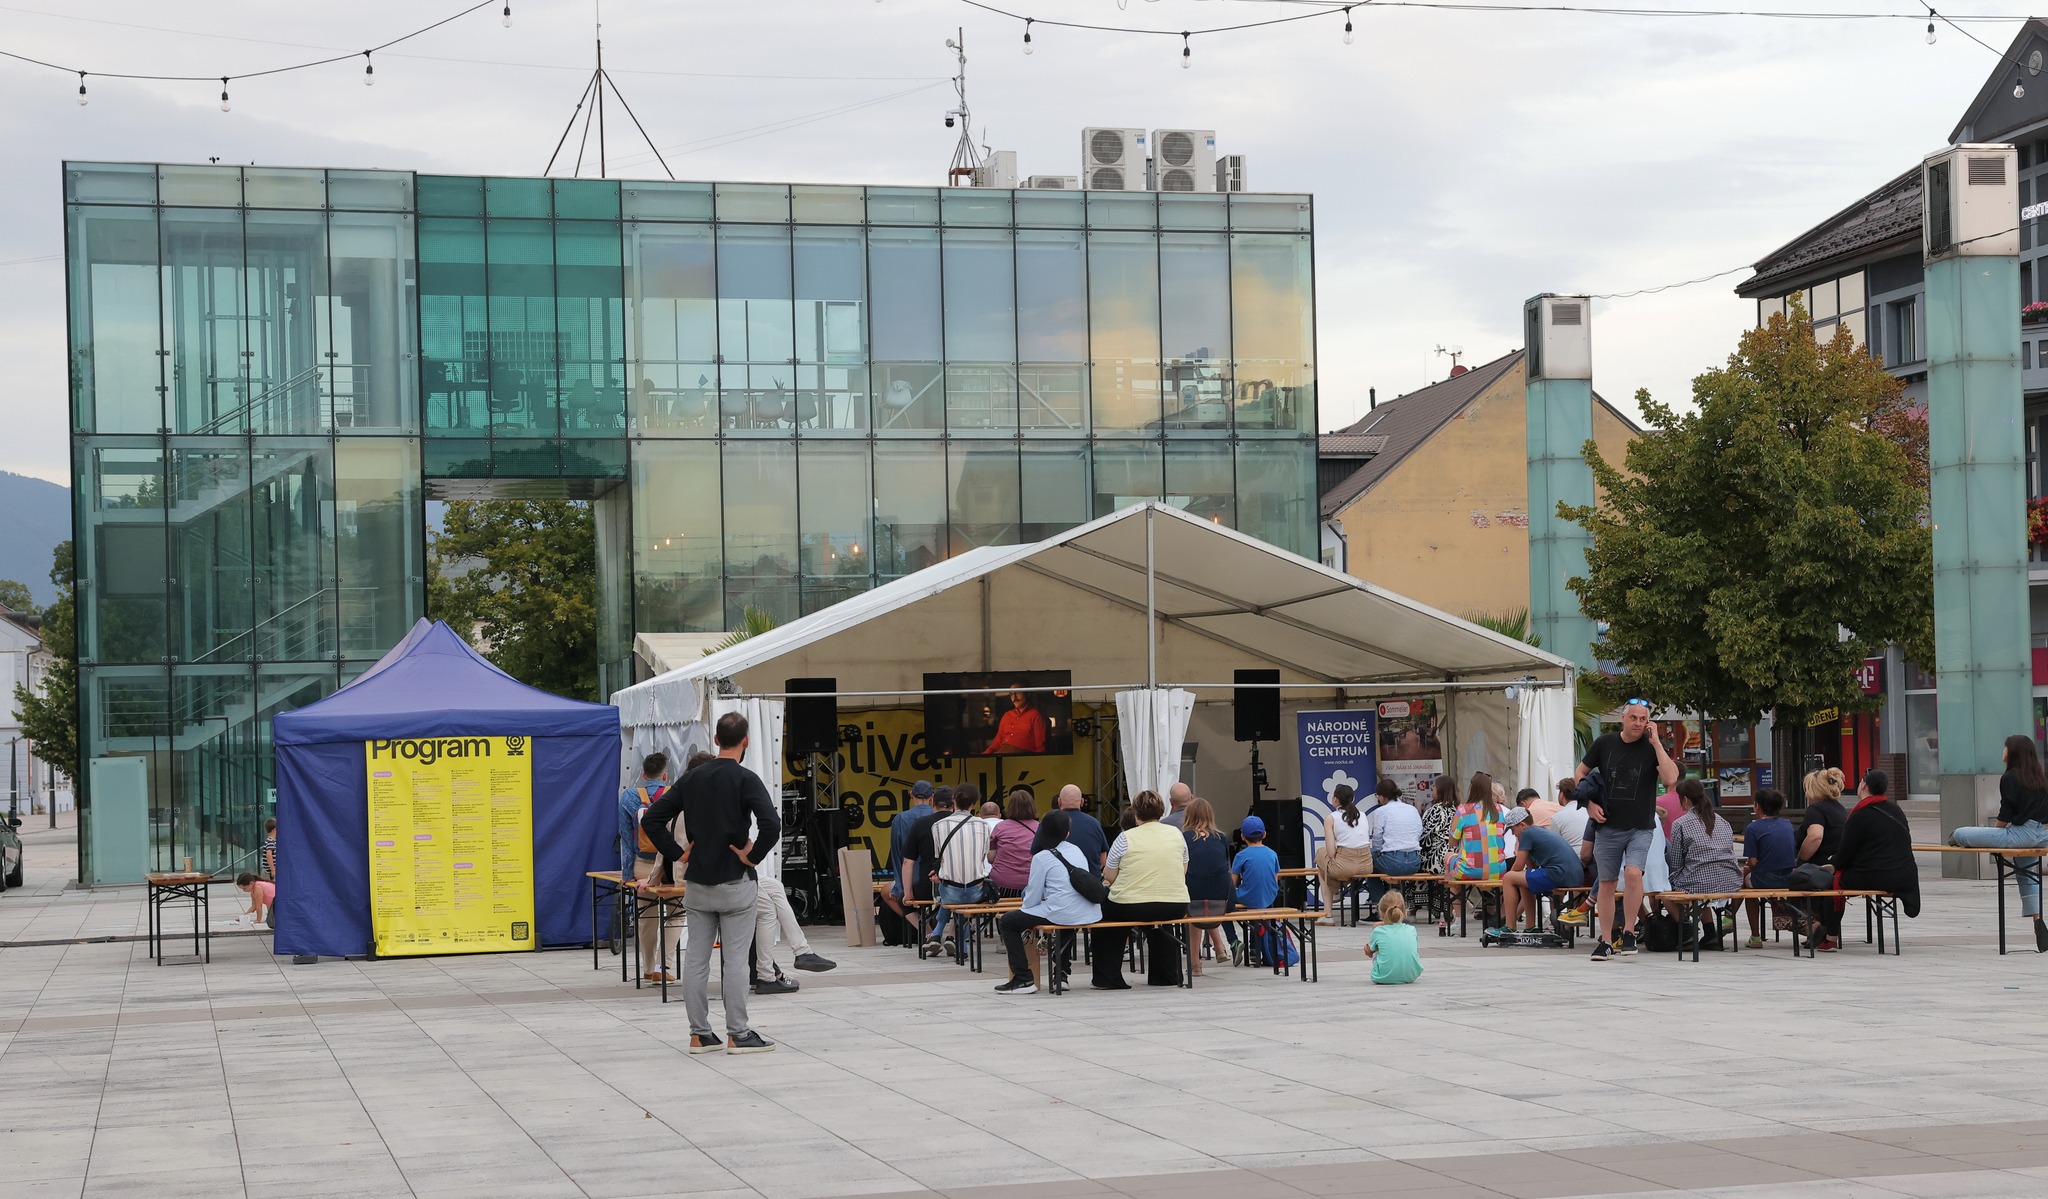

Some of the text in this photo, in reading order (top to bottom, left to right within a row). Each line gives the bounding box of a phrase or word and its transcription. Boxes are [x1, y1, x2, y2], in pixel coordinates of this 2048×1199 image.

[1856, 666, 1875, 689] T
[1307, 718, 1367, 732] NÁRODNÉ
[1305, 731, 1370, 745] OSVETOVÉ
[372, 738, 490, 765] Program
[1309, 746, 1368, 757] CENTRUM
